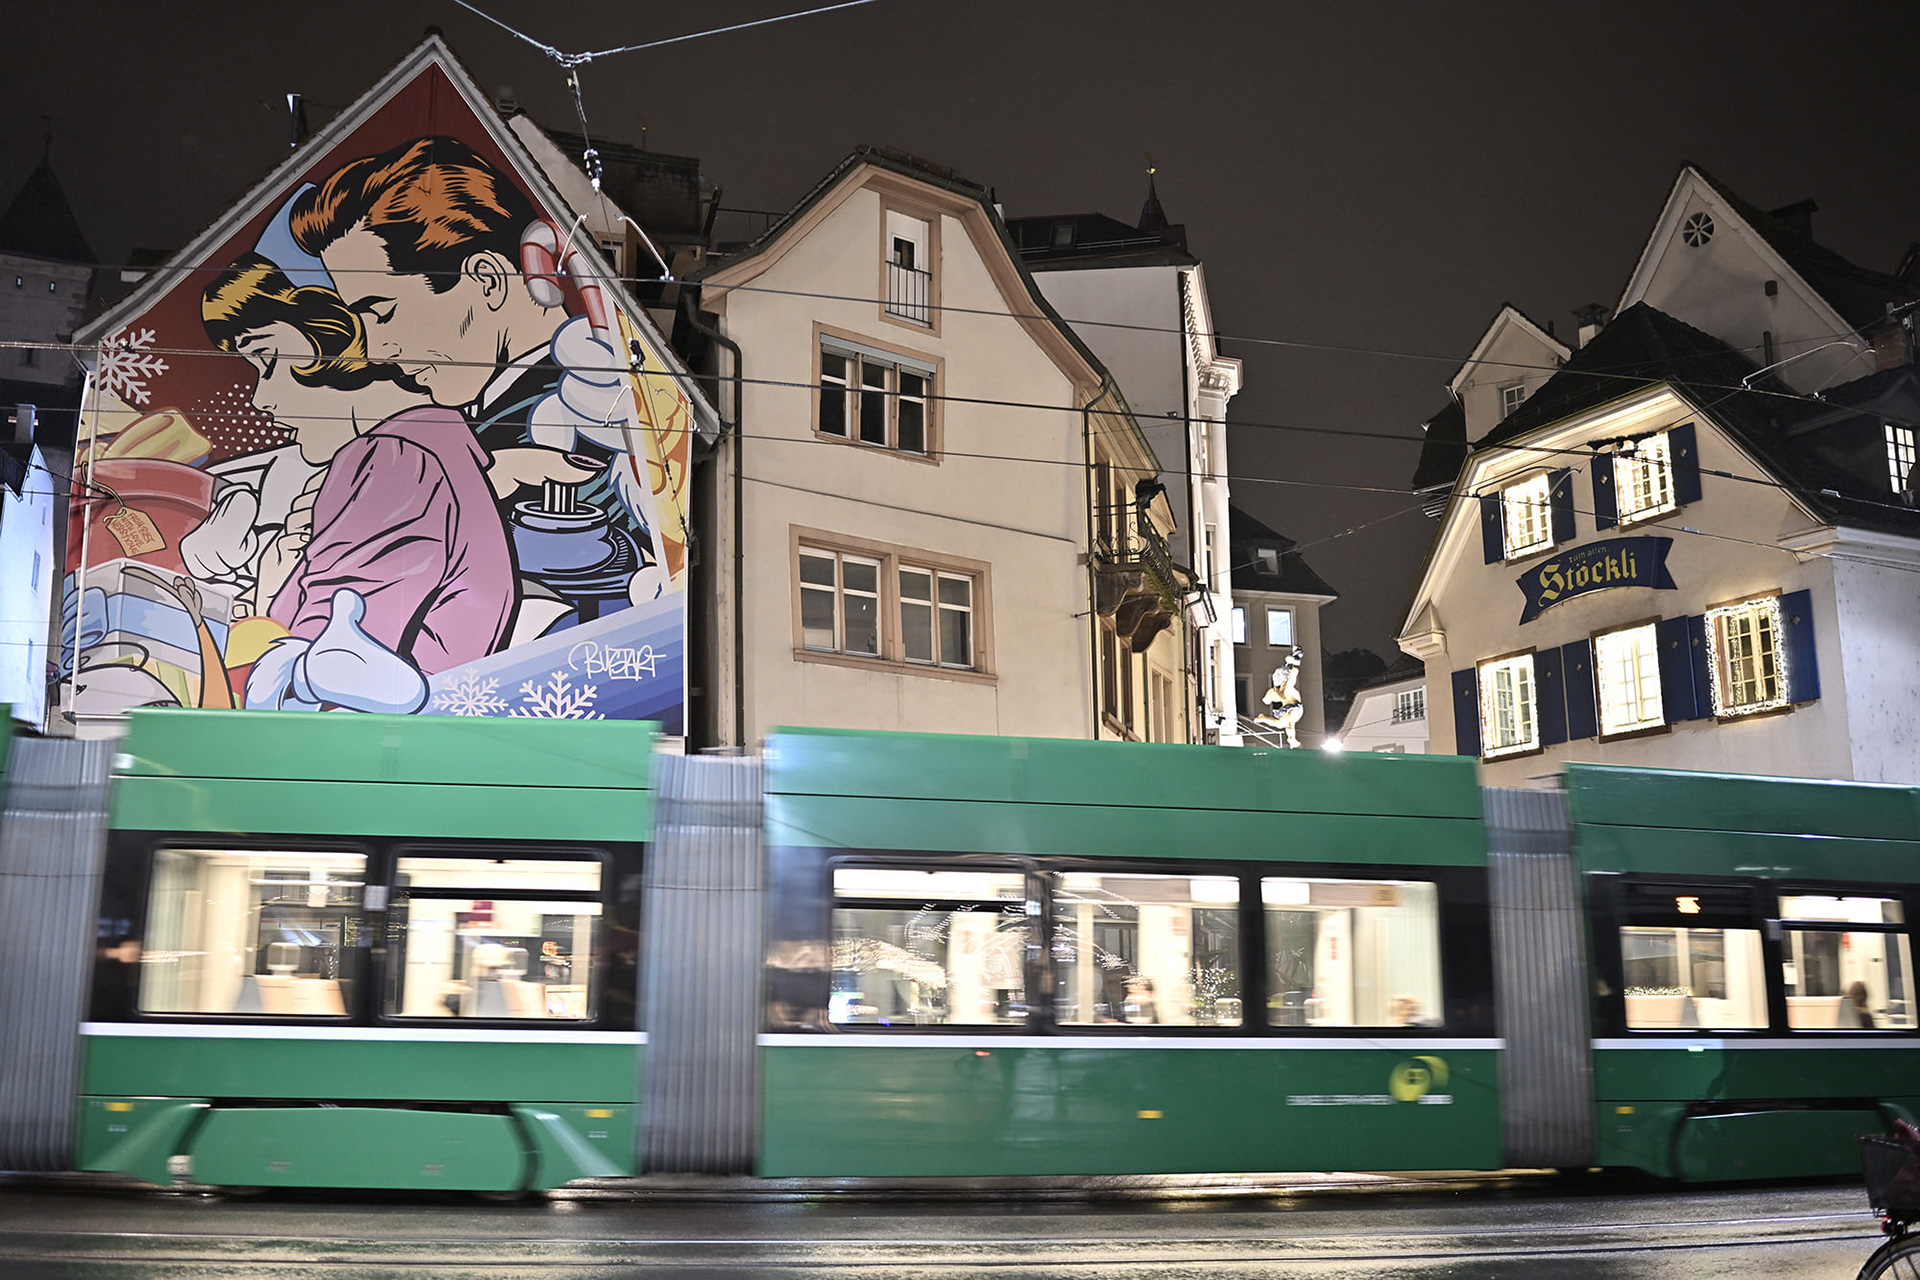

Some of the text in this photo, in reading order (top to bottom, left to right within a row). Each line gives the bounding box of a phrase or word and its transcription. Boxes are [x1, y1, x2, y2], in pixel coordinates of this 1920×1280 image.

[121, 518, 145, 548] WITH LOVE
[128, 513, 144, 527] FROM
[1538, 548, 1637, 607] Stöckli
